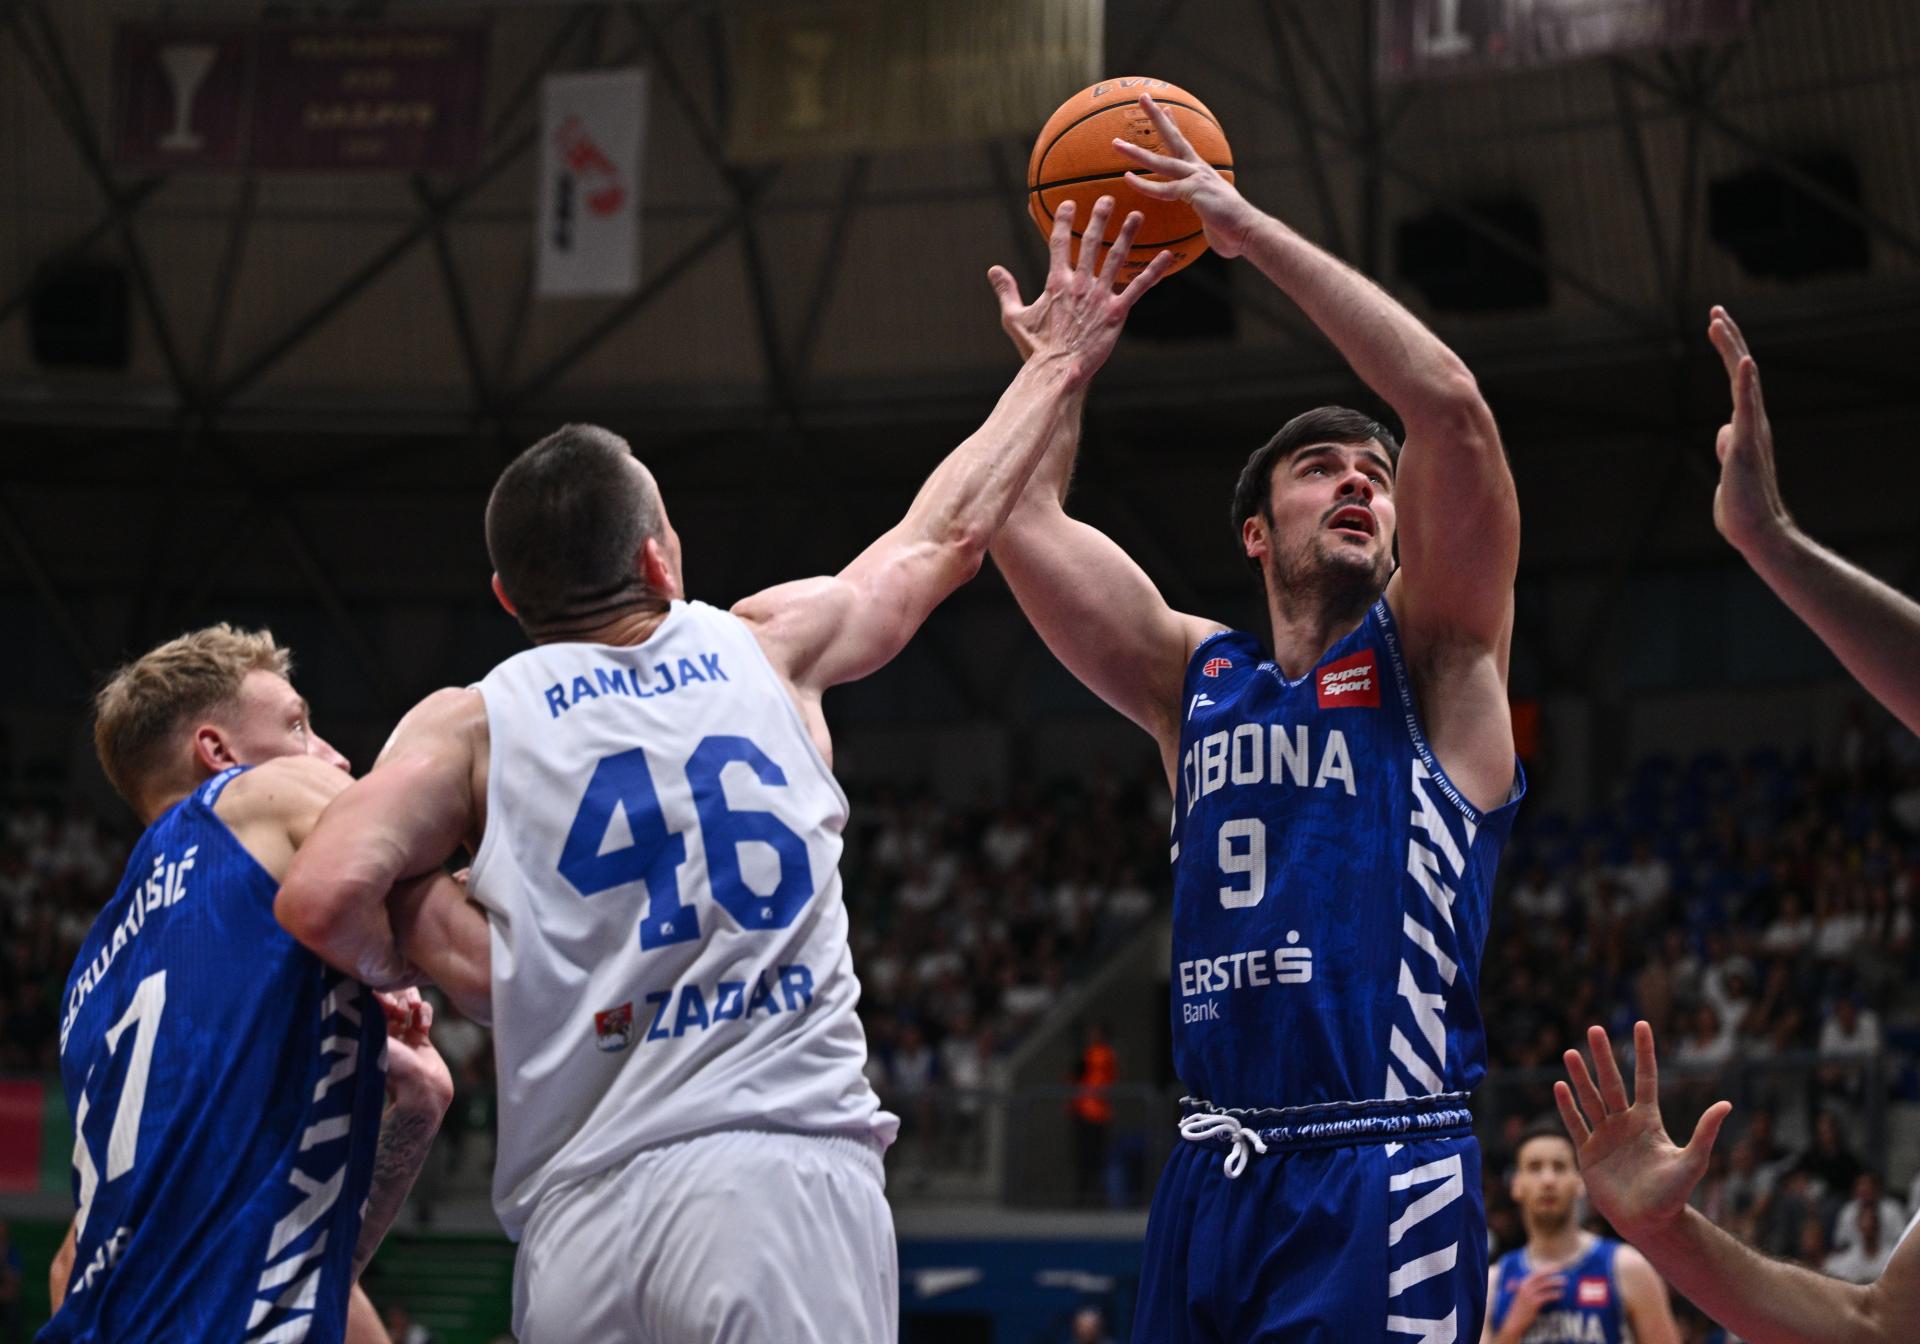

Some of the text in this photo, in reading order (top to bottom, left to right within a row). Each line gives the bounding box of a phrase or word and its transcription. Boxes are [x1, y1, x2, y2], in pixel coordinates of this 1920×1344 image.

[545, 652, 730, 719] RAMLJAK
[1321, 664, 1371, 684] Super
[1324, 678, 1371, 697] Sport
[1184, 724, 1356, 817] CIBONA
[557, 735, 815, 953] 46
[1217, 817, 1267, 911] 9
[645, 963, 815, 1043] ZADAR
[1178, 948, 1271, 998] ERSTE
[1182, 998, 1220, 1025] Bank
